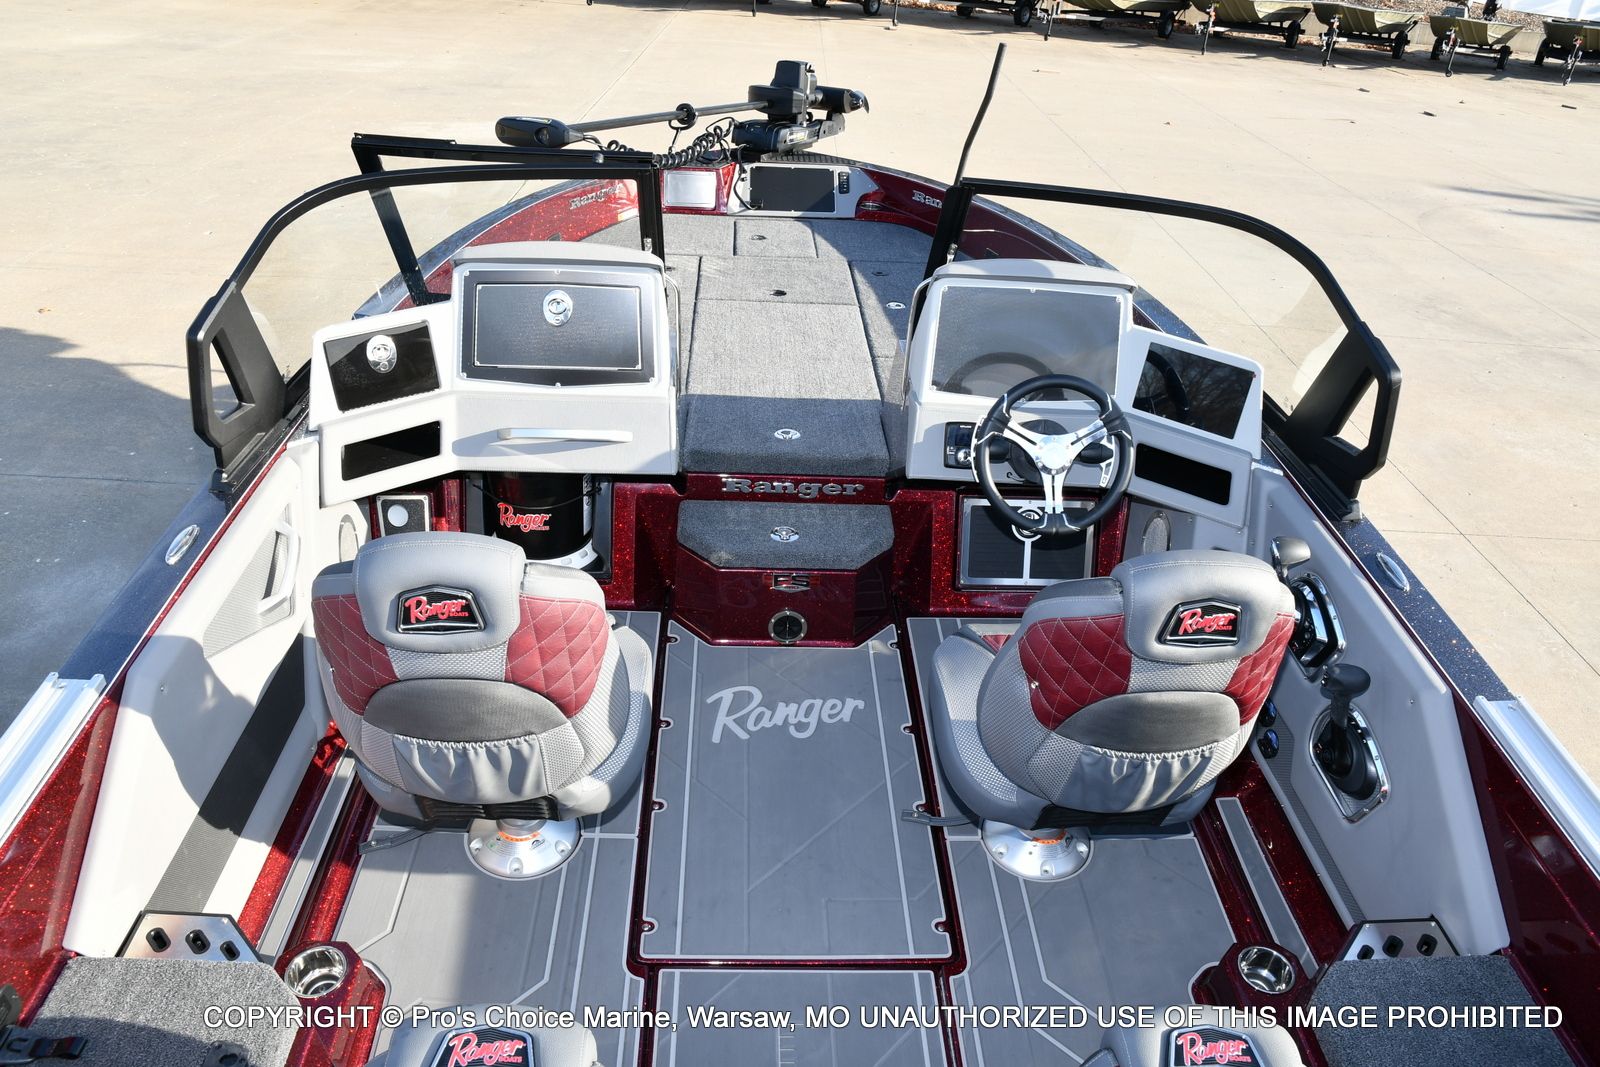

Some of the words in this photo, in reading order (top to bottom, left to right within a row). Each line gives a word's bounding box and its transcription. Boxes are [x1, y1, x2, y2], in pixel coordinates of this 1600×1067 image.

[569, 184, 623, 210] Ranger
[911, 189, 943, 208] Ran
[721, 477, 864, 499] Ranger
[497, 502, 550, 533] Ranger
[404, 596, 466, 624] Ranger
[1178, 608, 1236, 635] Ranger
[706, 685, 865, 744] Ranger
[448, 1032, 524, 1067] Ranger
[1176, 1032, 1246, 1066] Ranger
